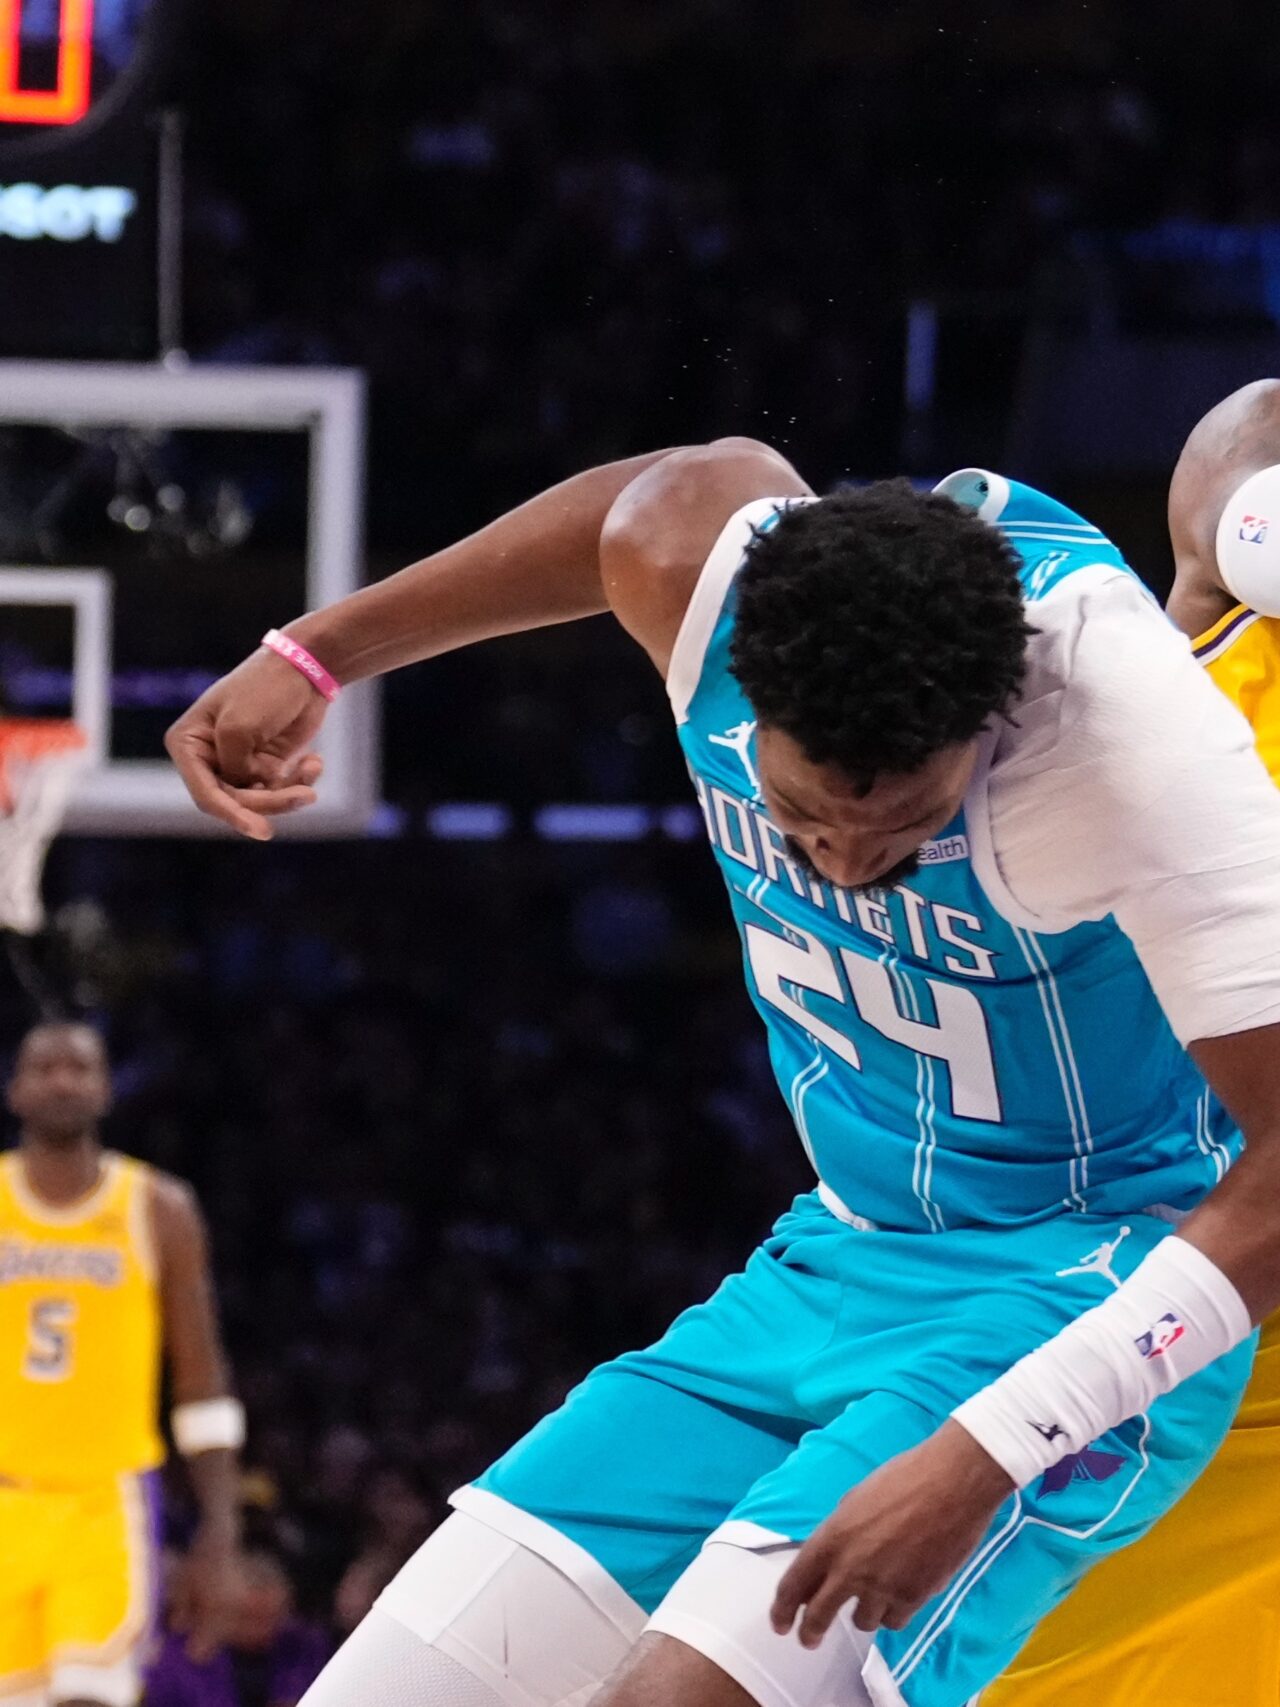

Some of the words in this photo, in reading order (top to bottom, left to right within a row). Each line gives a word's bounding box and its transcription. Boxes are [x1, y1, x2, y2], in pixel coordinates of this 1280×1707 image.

[917, 838, 965, 861] ealth
[743, 920, 1003, 1124] 24
[22, 1297, 79, 1383] 5
